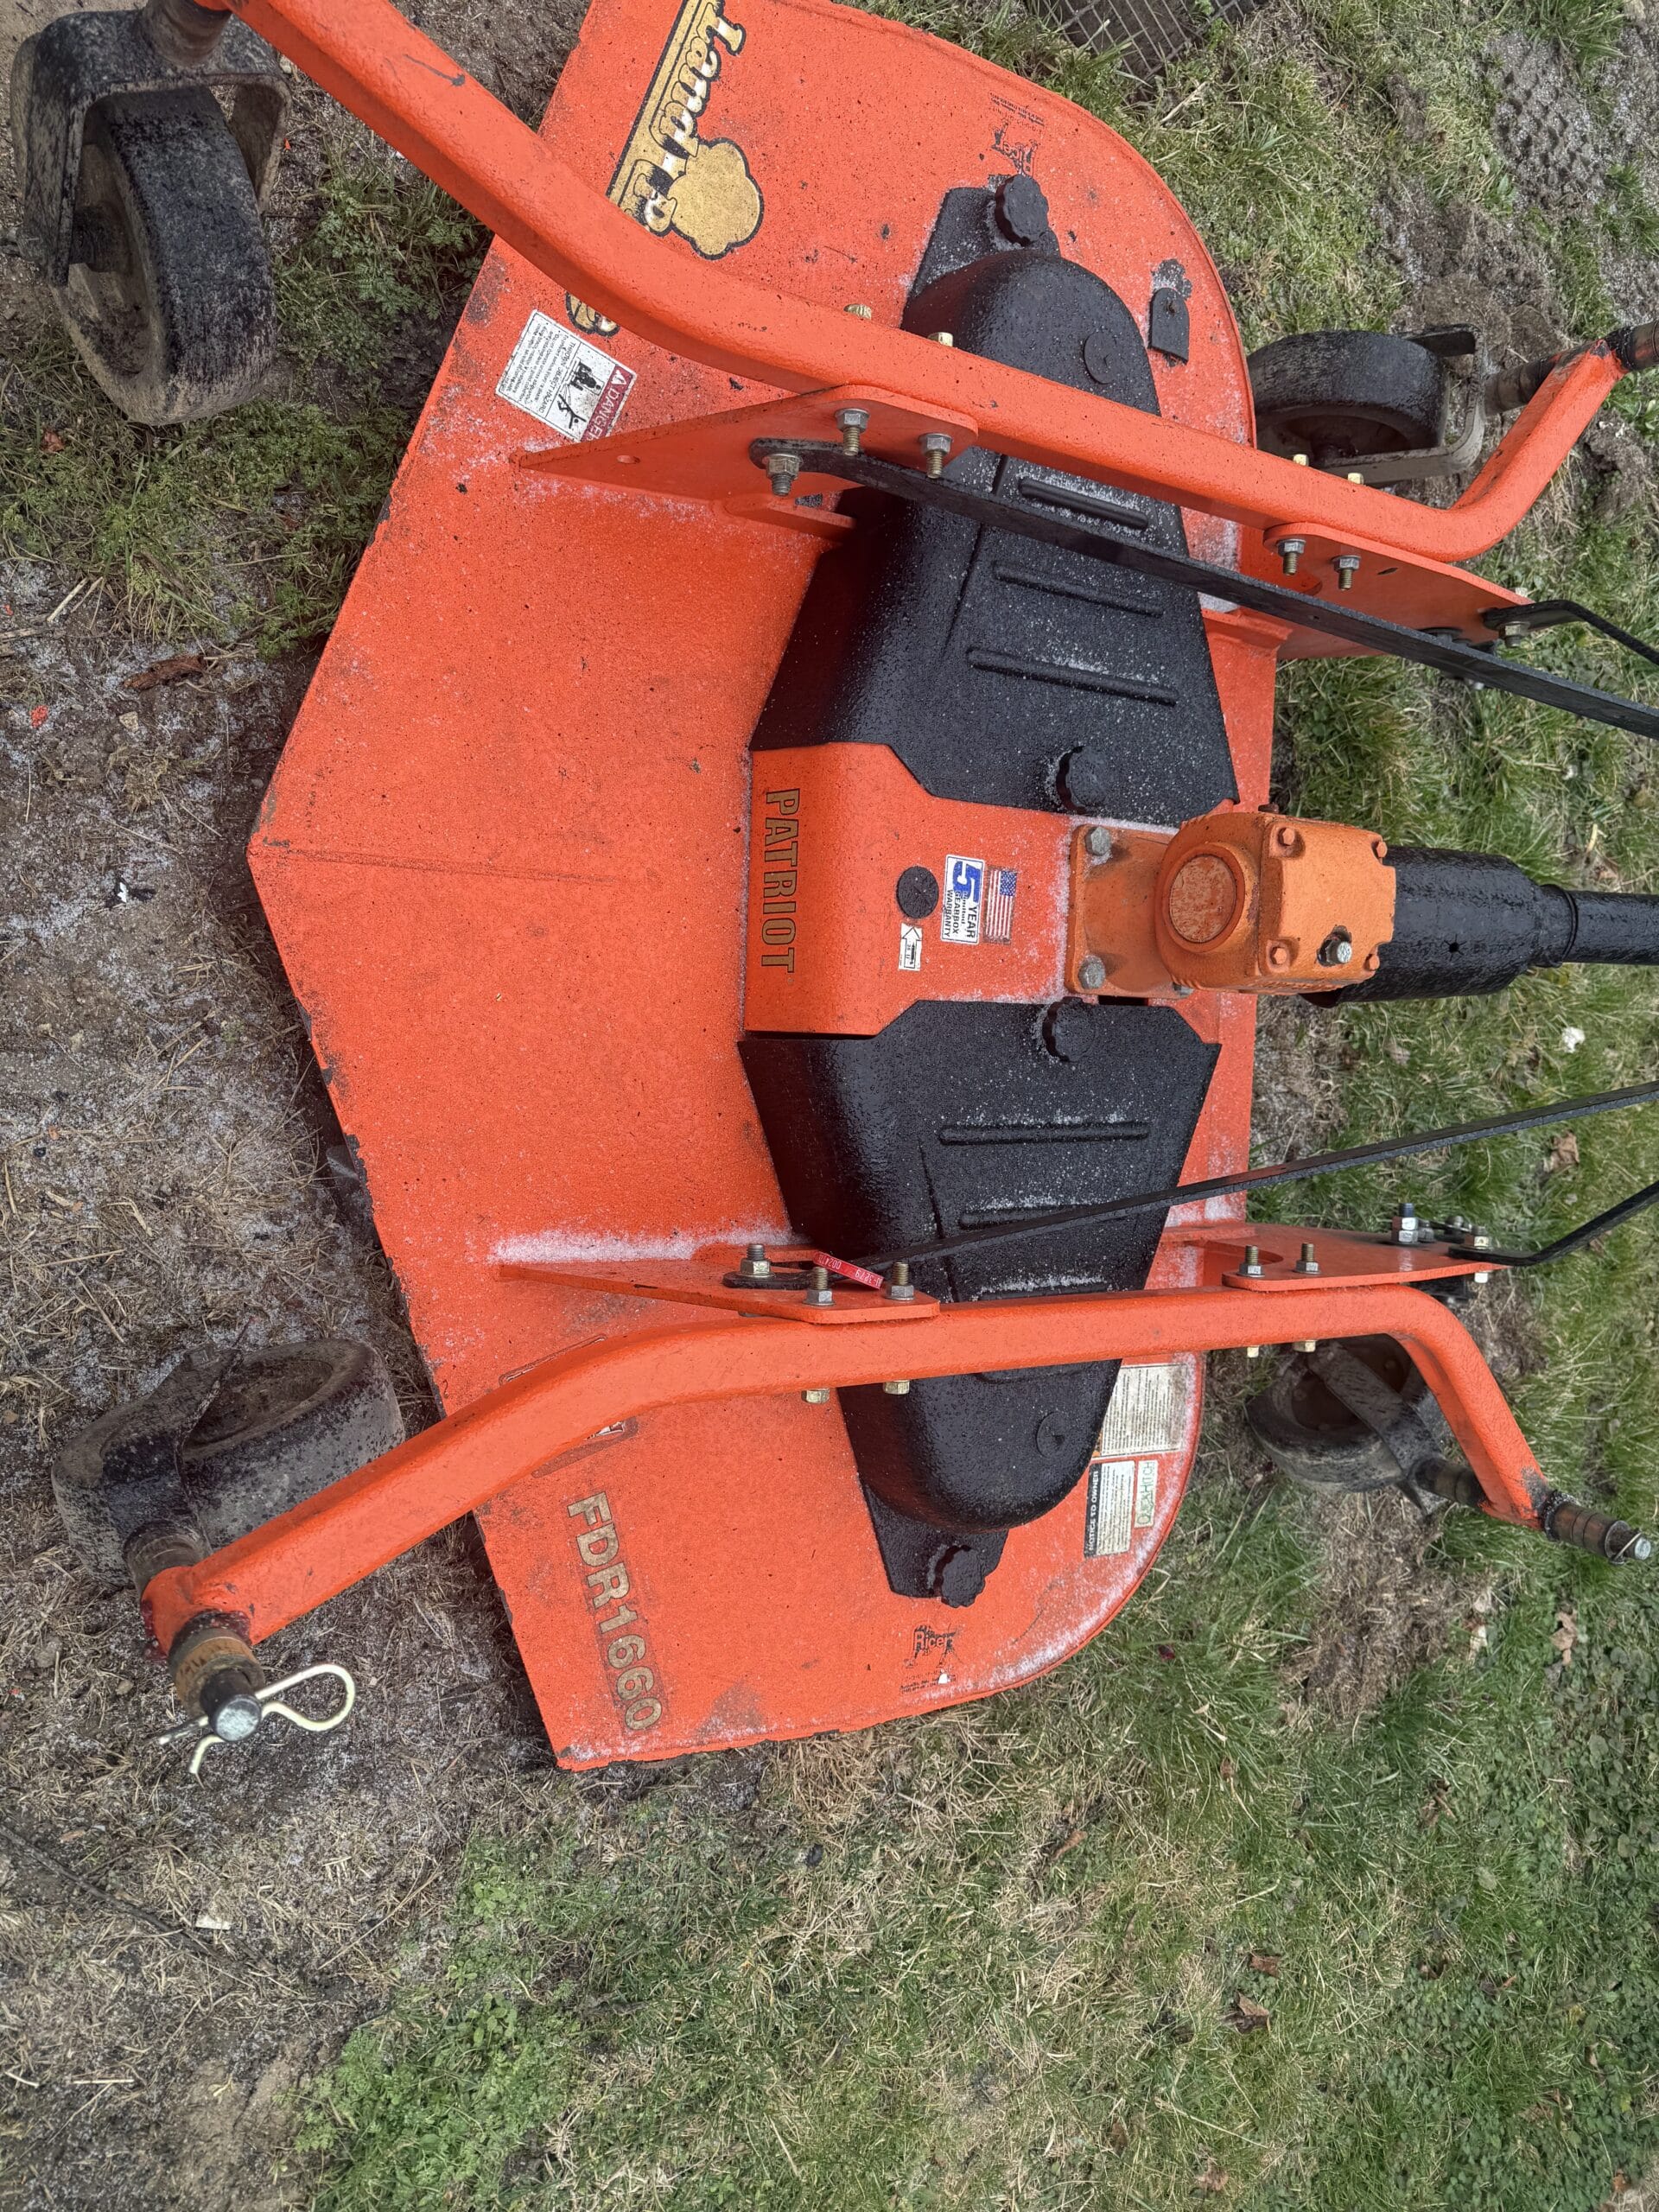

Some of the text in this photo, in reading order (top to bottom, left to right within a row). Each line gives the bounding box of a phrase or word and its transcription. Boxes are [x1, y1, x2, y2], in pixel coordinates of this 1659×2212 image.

[658, 2, 746, 157] Land
[538, 341, 575, 413] THROWN OBJECT HAZARD
[586, 389, 620, 442] DANGER
[761, 788, 799, 974] PATRIOT
[944, 890, 954, 938] WARRANTY
[952, 861, 981, 938] 5 YEAR
[952, 891, 962, 934] GEARBOX
[1090, 1506, 1096, 1517] TO
[567, 1491, 663, 1730] FDR1660
